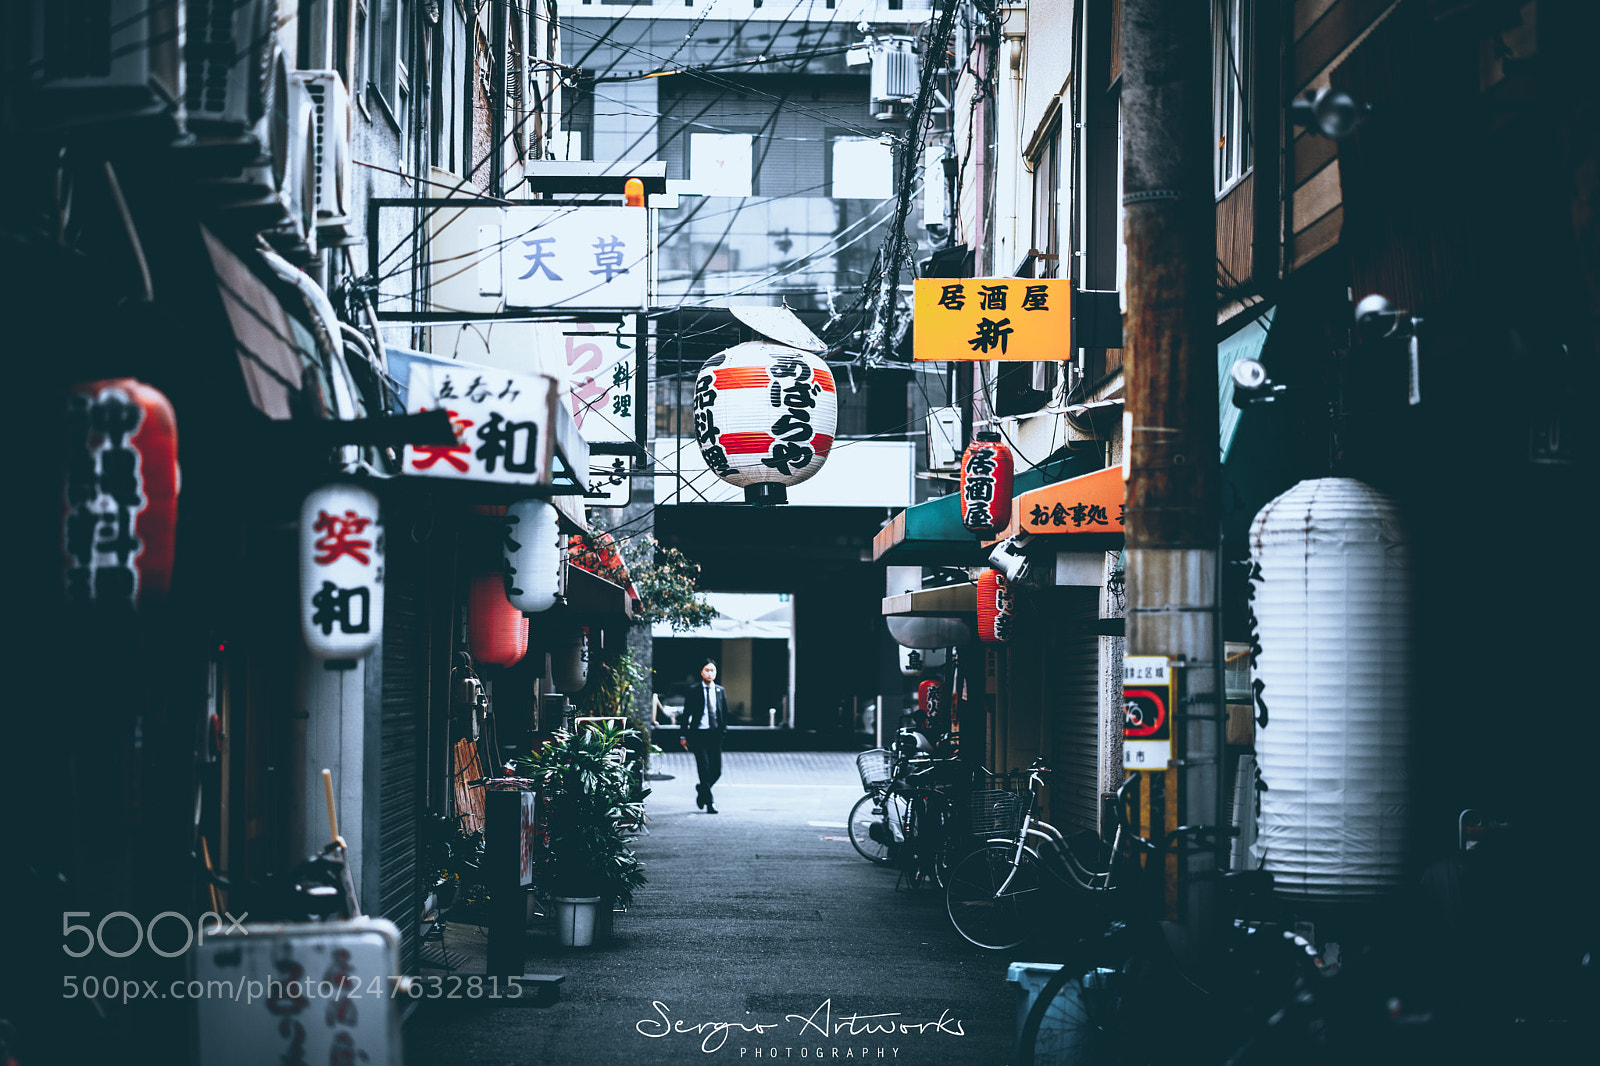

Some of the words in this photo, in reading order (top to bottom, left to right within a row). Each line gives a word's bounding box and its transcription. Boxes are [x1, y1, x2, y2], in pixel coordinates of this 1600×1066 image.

[518, 234, 630, 283] 天草
[937, 284, 1050, 311] 居酒屋
[967, 317, 1014, 355] 新
[965, 449, 997, 529] 居酒屋
[1030, 502, 1109, 527] お食事処
[312, 510, 371, 636] 笑和
